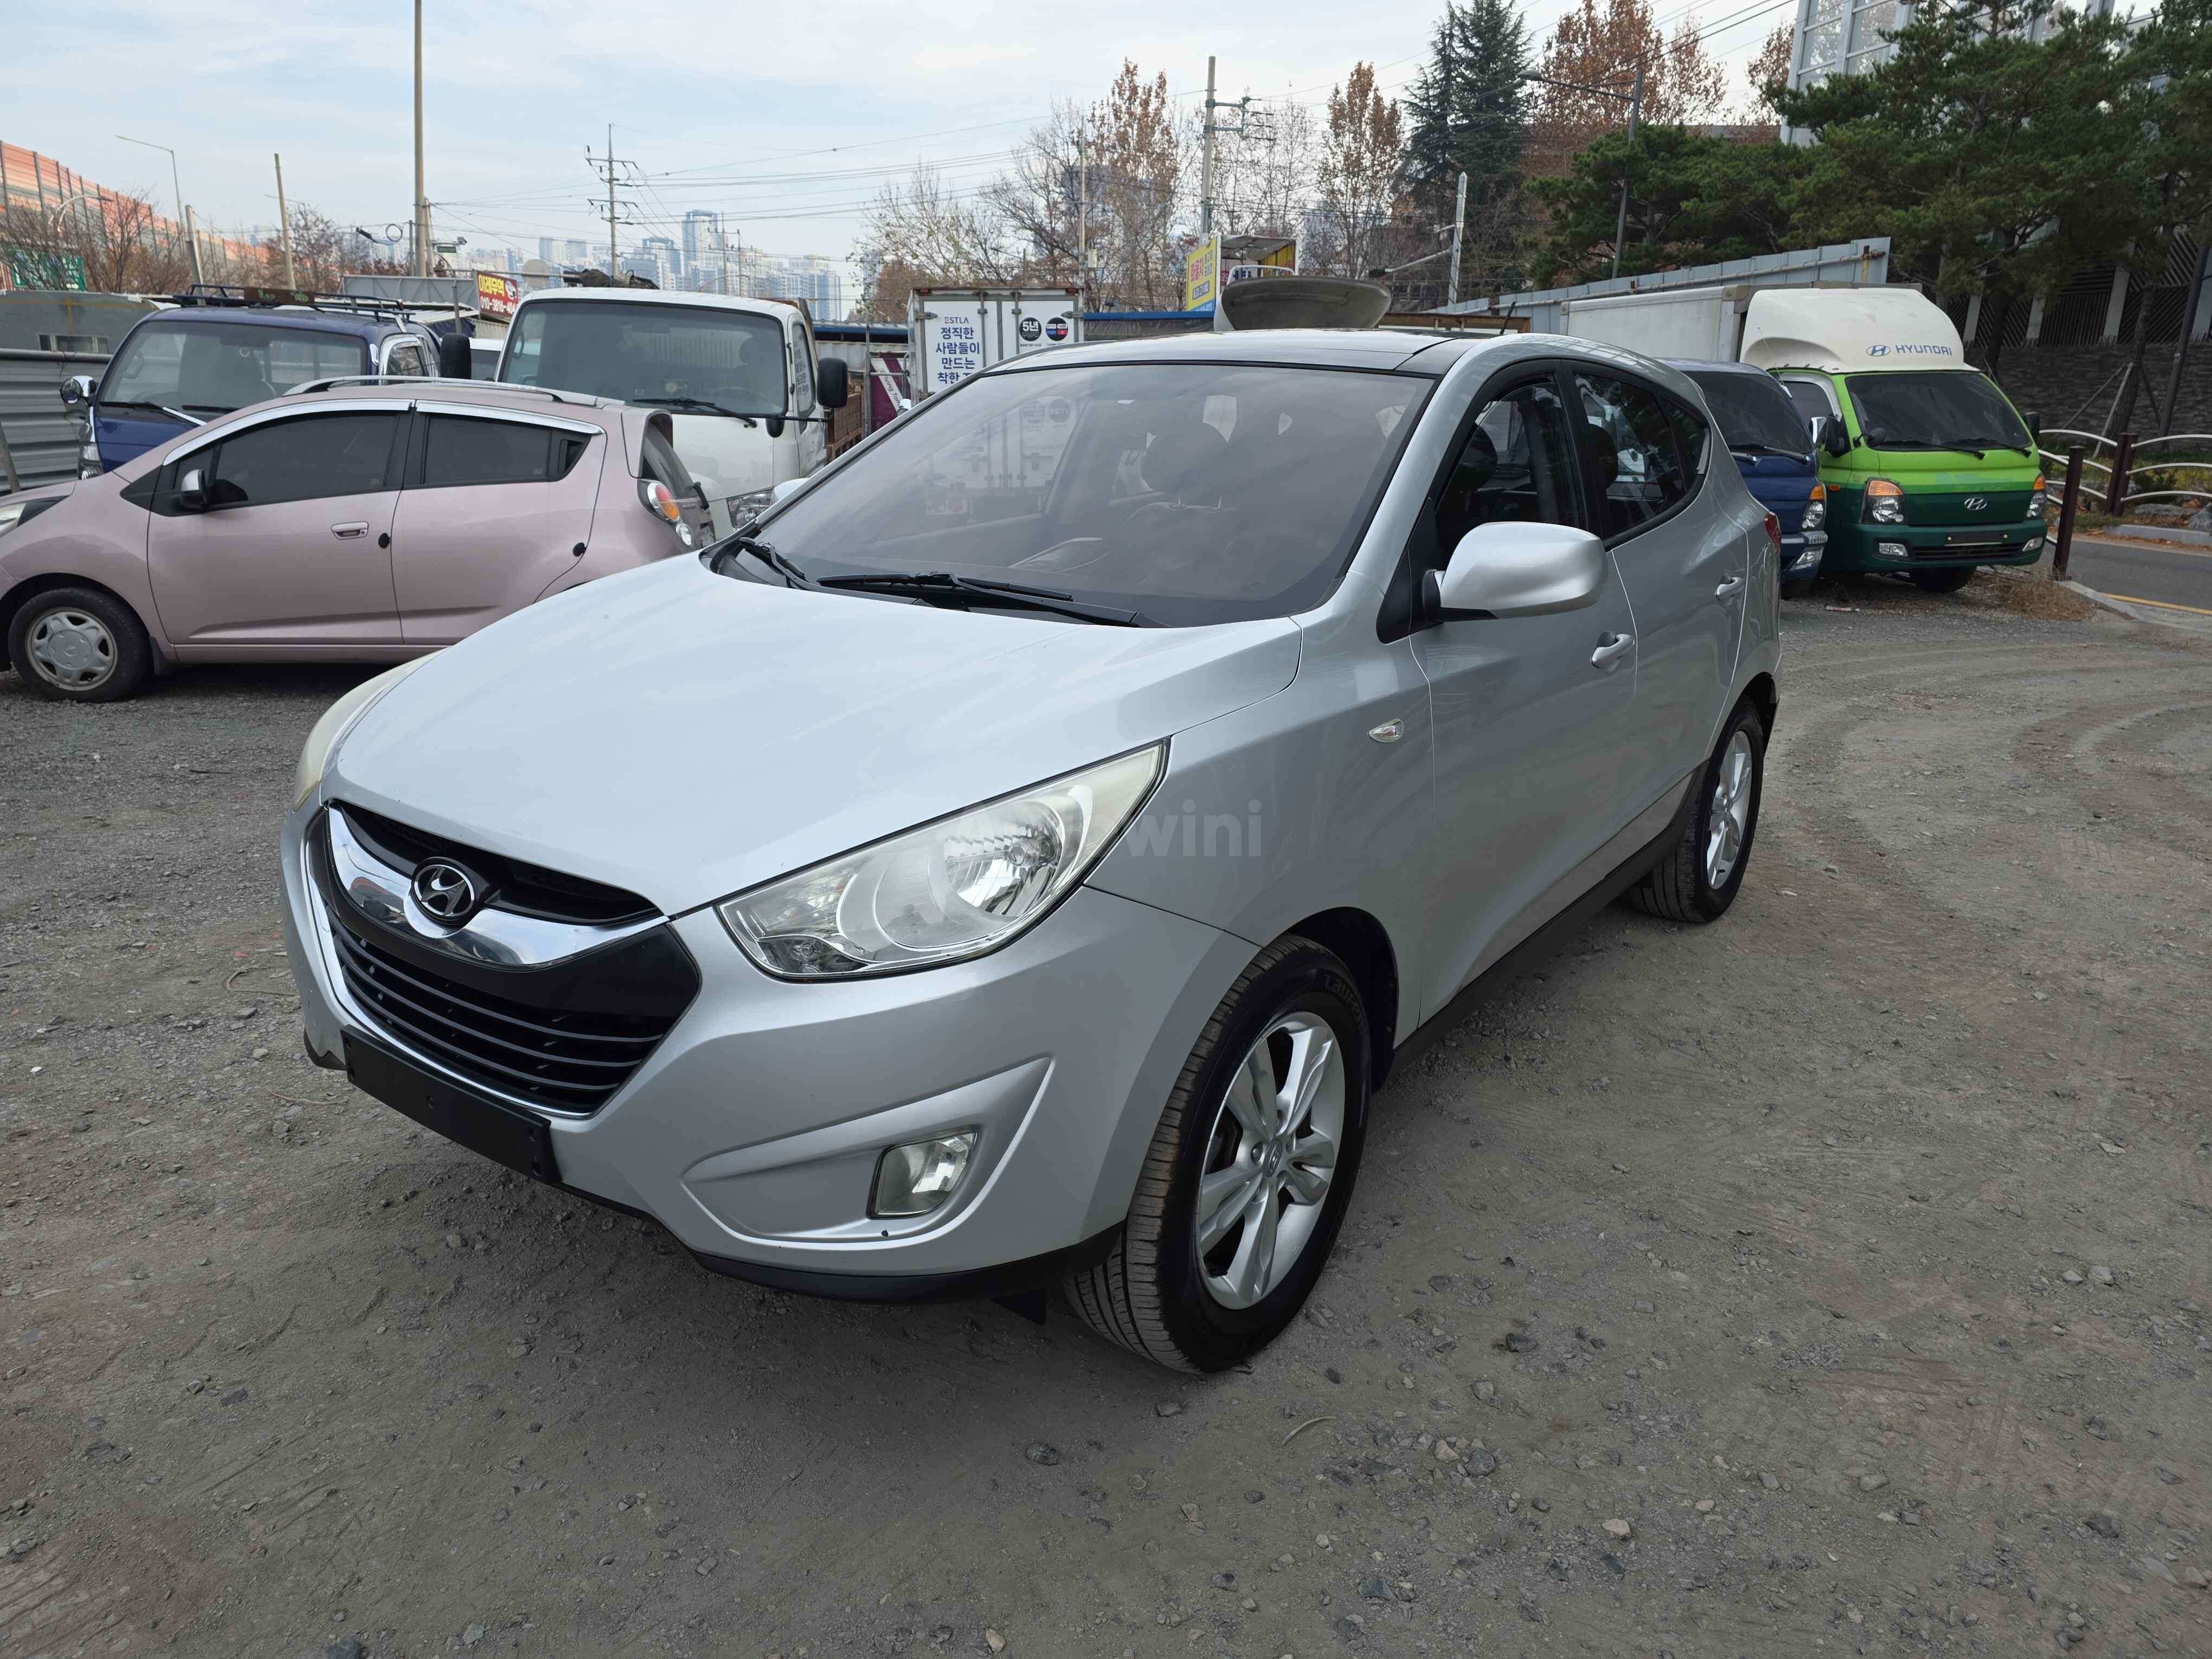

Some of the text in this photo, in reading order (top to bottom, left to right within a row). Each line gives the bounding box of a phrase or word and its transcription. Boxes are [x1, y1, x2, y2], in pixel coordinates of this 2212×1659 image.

[1023, 321, 1039, 331] 5년
[941, 327, 974, 339] 정직한
[936, 342, 980, 354] 사람들이
[1895, 345, 1952, 356] HYUNDAI
[942, 357, 975, 369] 만드는
[937, 372, 960, 384] 착한
